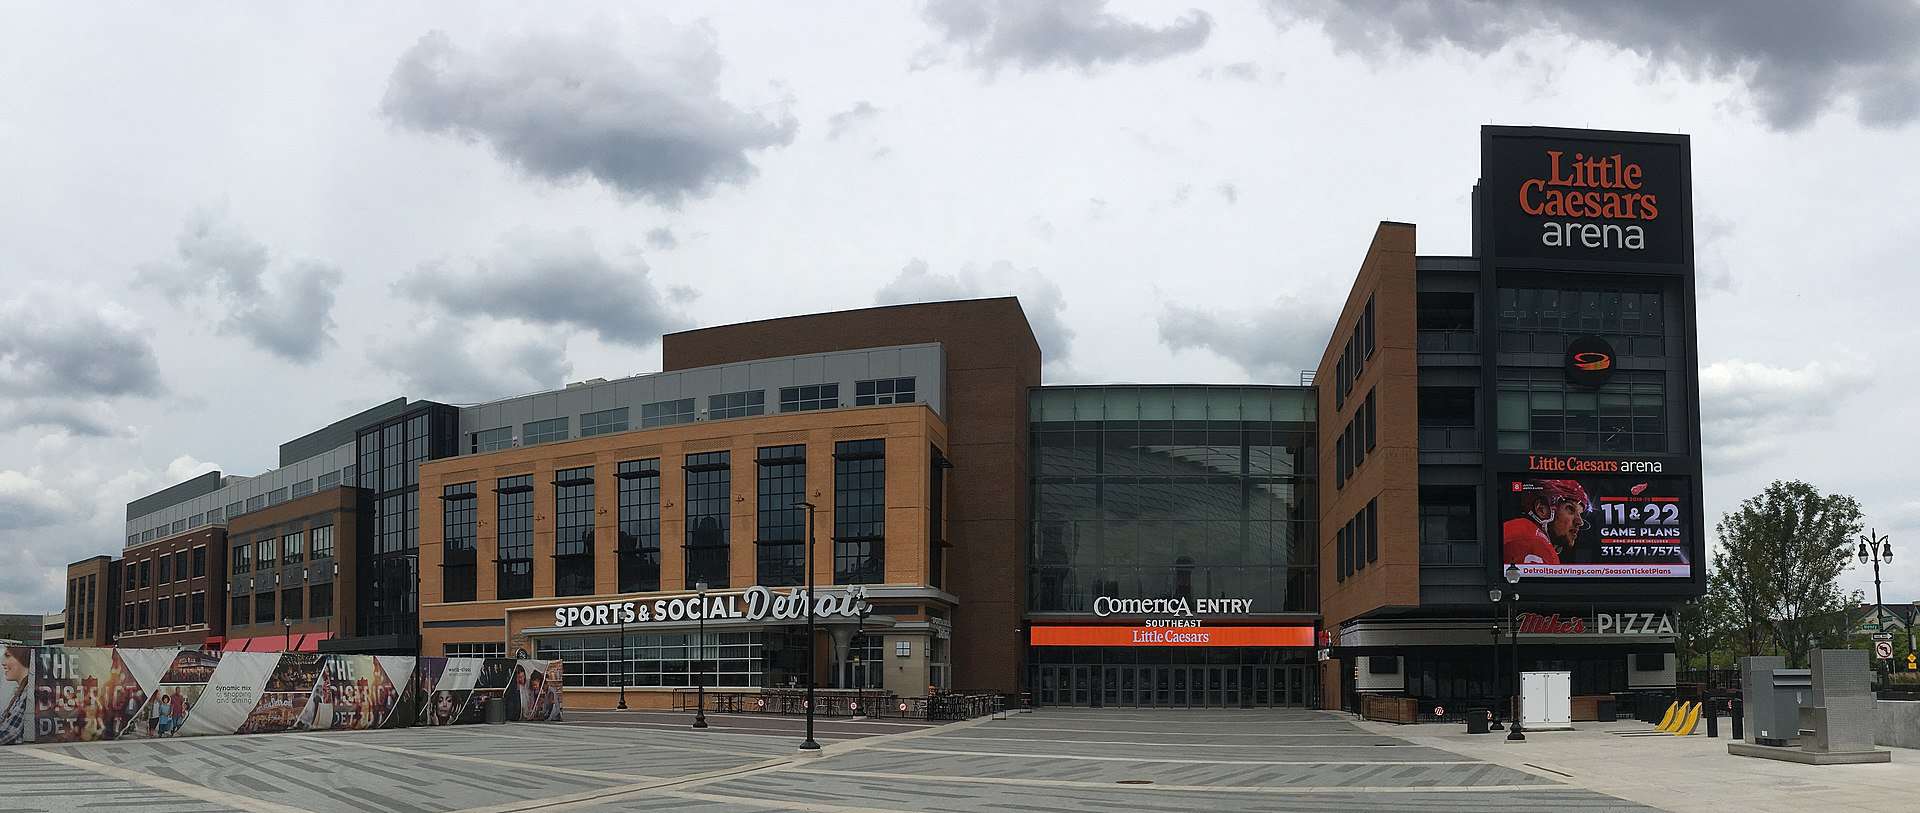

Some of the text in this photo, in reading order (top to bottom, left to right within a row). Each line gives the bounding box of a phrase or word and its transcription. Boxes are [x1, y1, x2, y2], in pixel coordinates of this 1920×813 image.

[1547, 150, 1642, 189] Little
[1519, 178, 1658, 220] Caesars
[1542, 221, 1645, 249] arena
[1529, 455, 1662, 472] Little Caesars arena
[1601, 503, 1679, 525] 11 & 22
[1600, 527, 1680, 537] GAME PLANS
[1600, 546, 1681, 556] 313.471.7575
[1523, 567, 1671, 575] DetroitRedWings.com/SeasonTicketPlans
[555, 584, 872, 627] SPORTS & SOCIAL Detroit
[1196, 598, 1254, 614] ENTRY
[1145, 619, 1202, 628] SOUTHEAST
[1597, 613, 1675, 634] PIZZA
[1132, 629, 1209, 643] Little Caesars
[39, 653, 80, 679] THE
